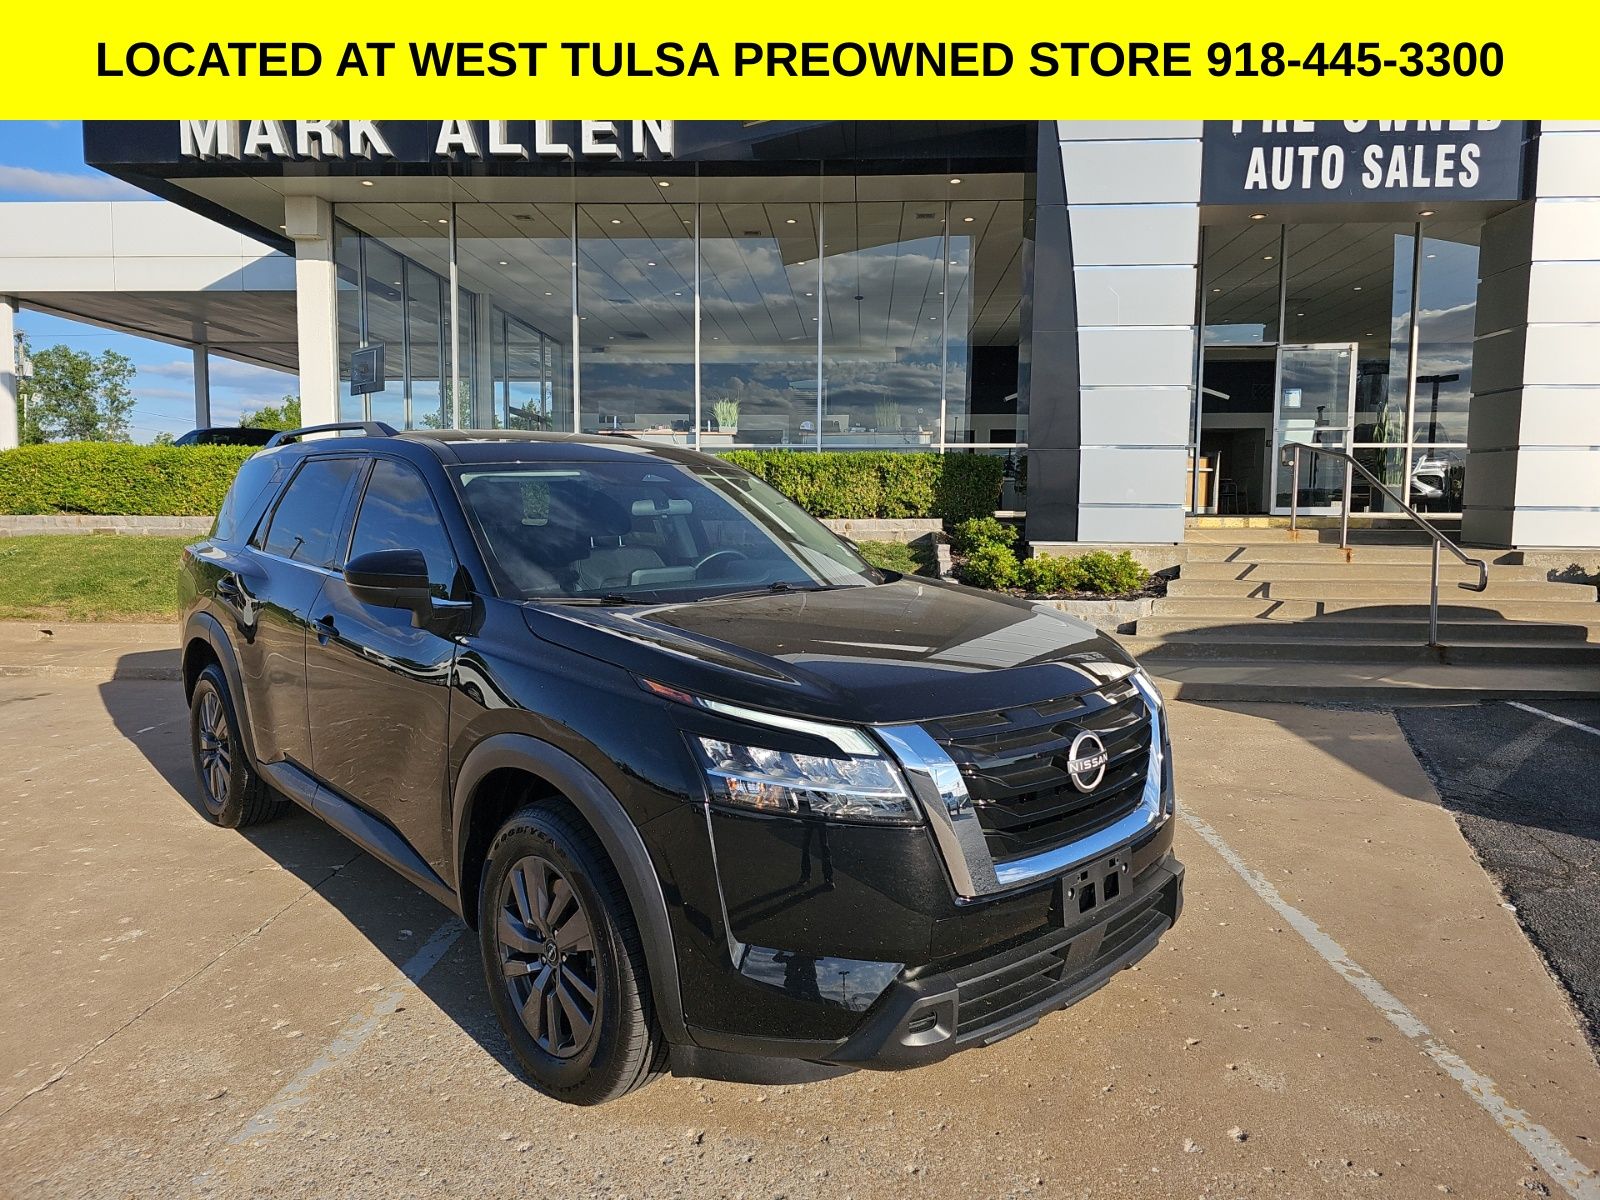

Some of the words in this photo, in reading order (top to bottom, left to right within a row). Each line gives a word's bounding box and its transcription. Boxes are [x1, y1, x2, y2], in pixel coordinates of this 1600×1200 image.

[180, 120, 394, 158] MARK
[435, 120, 674, 158] ALLEN
[1244, 145, 1345, 190] AUTO
[1362, 143, 1481, 188] SALES
[1069, 752, 1108, 773] NISSAN
